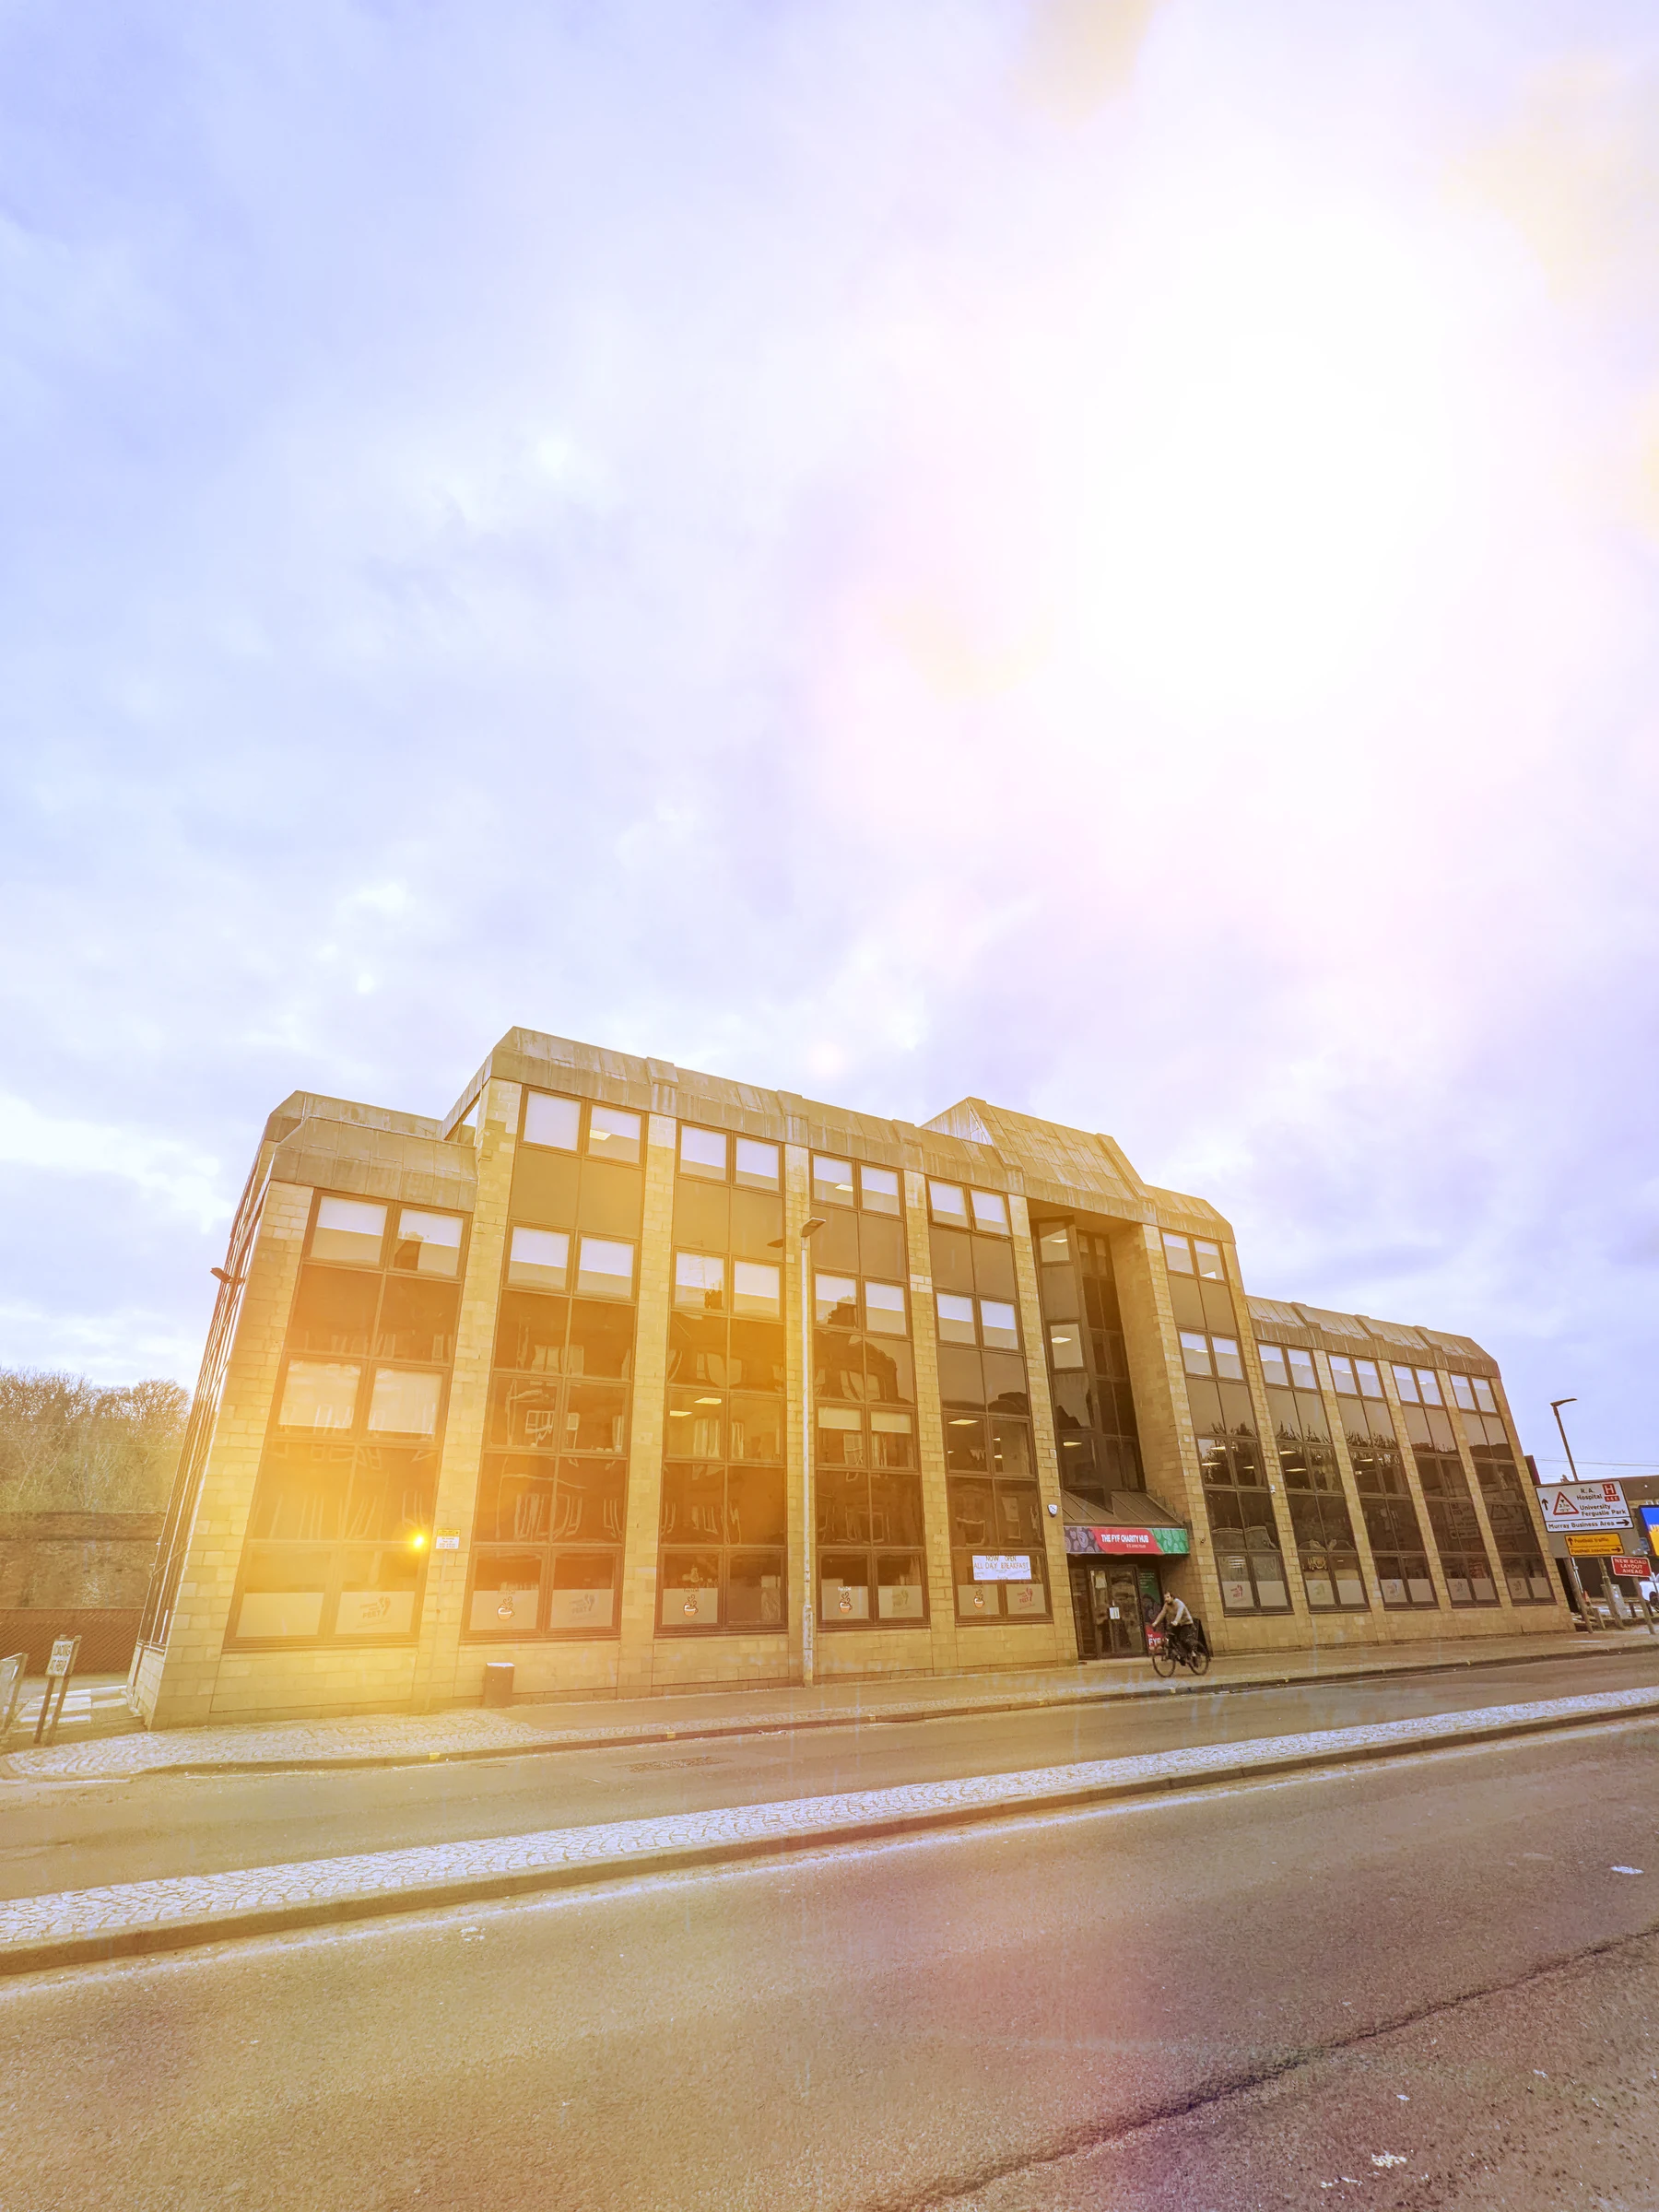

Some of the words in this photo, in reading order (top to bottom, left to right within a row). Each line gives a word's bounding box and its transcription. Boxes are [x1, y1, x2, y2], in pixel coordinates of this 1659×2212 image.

[1605, 1485, 1615, 1494] H
[1100, 1534, 1111, 1543] THE
[1112, 1534, 1120, 1543] FYF
[1121, 1535, 1139, 1543] CHARITY
[1139, 1535, 1149, 1543] HUB
